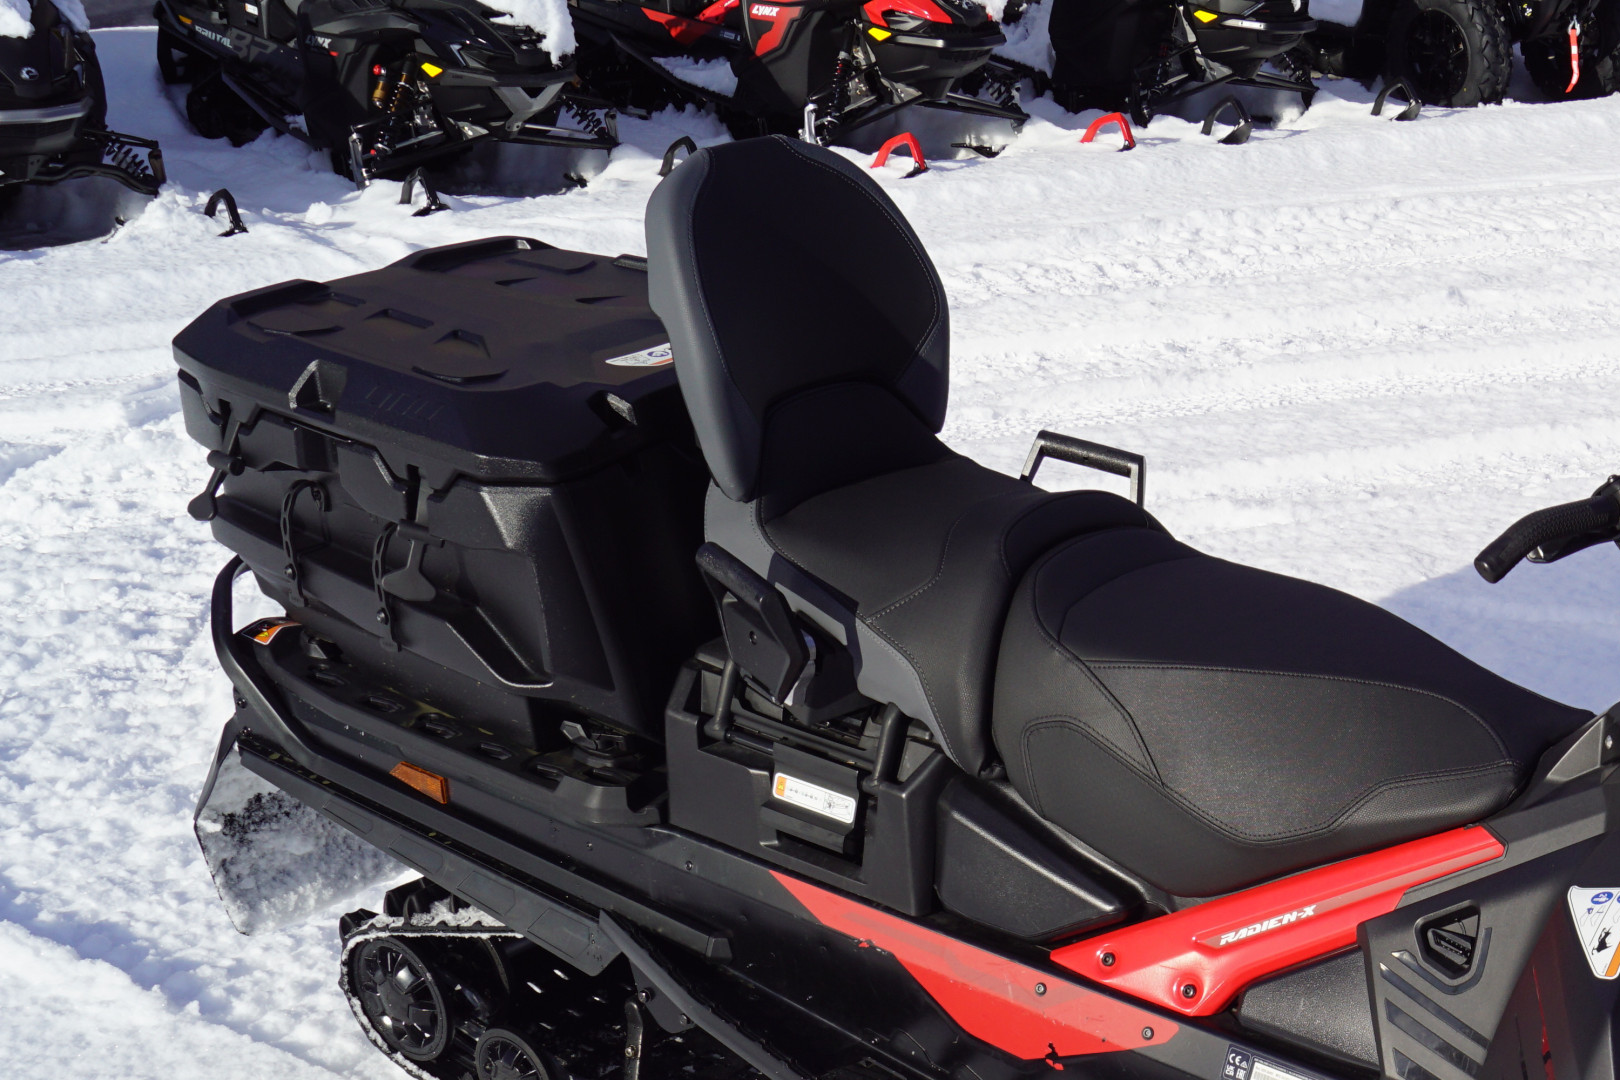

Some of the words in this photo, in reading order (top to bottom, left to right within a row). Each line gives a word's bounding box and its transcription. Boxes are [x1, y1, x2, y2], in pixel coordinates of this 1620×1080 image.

[752, 4, 780, 17] LYNX
[194, 24, 233, 49] BRUTAL
[304, 34, 332, 49] LYNX
[1219, 904, 1317, 946] RADIEN-X
